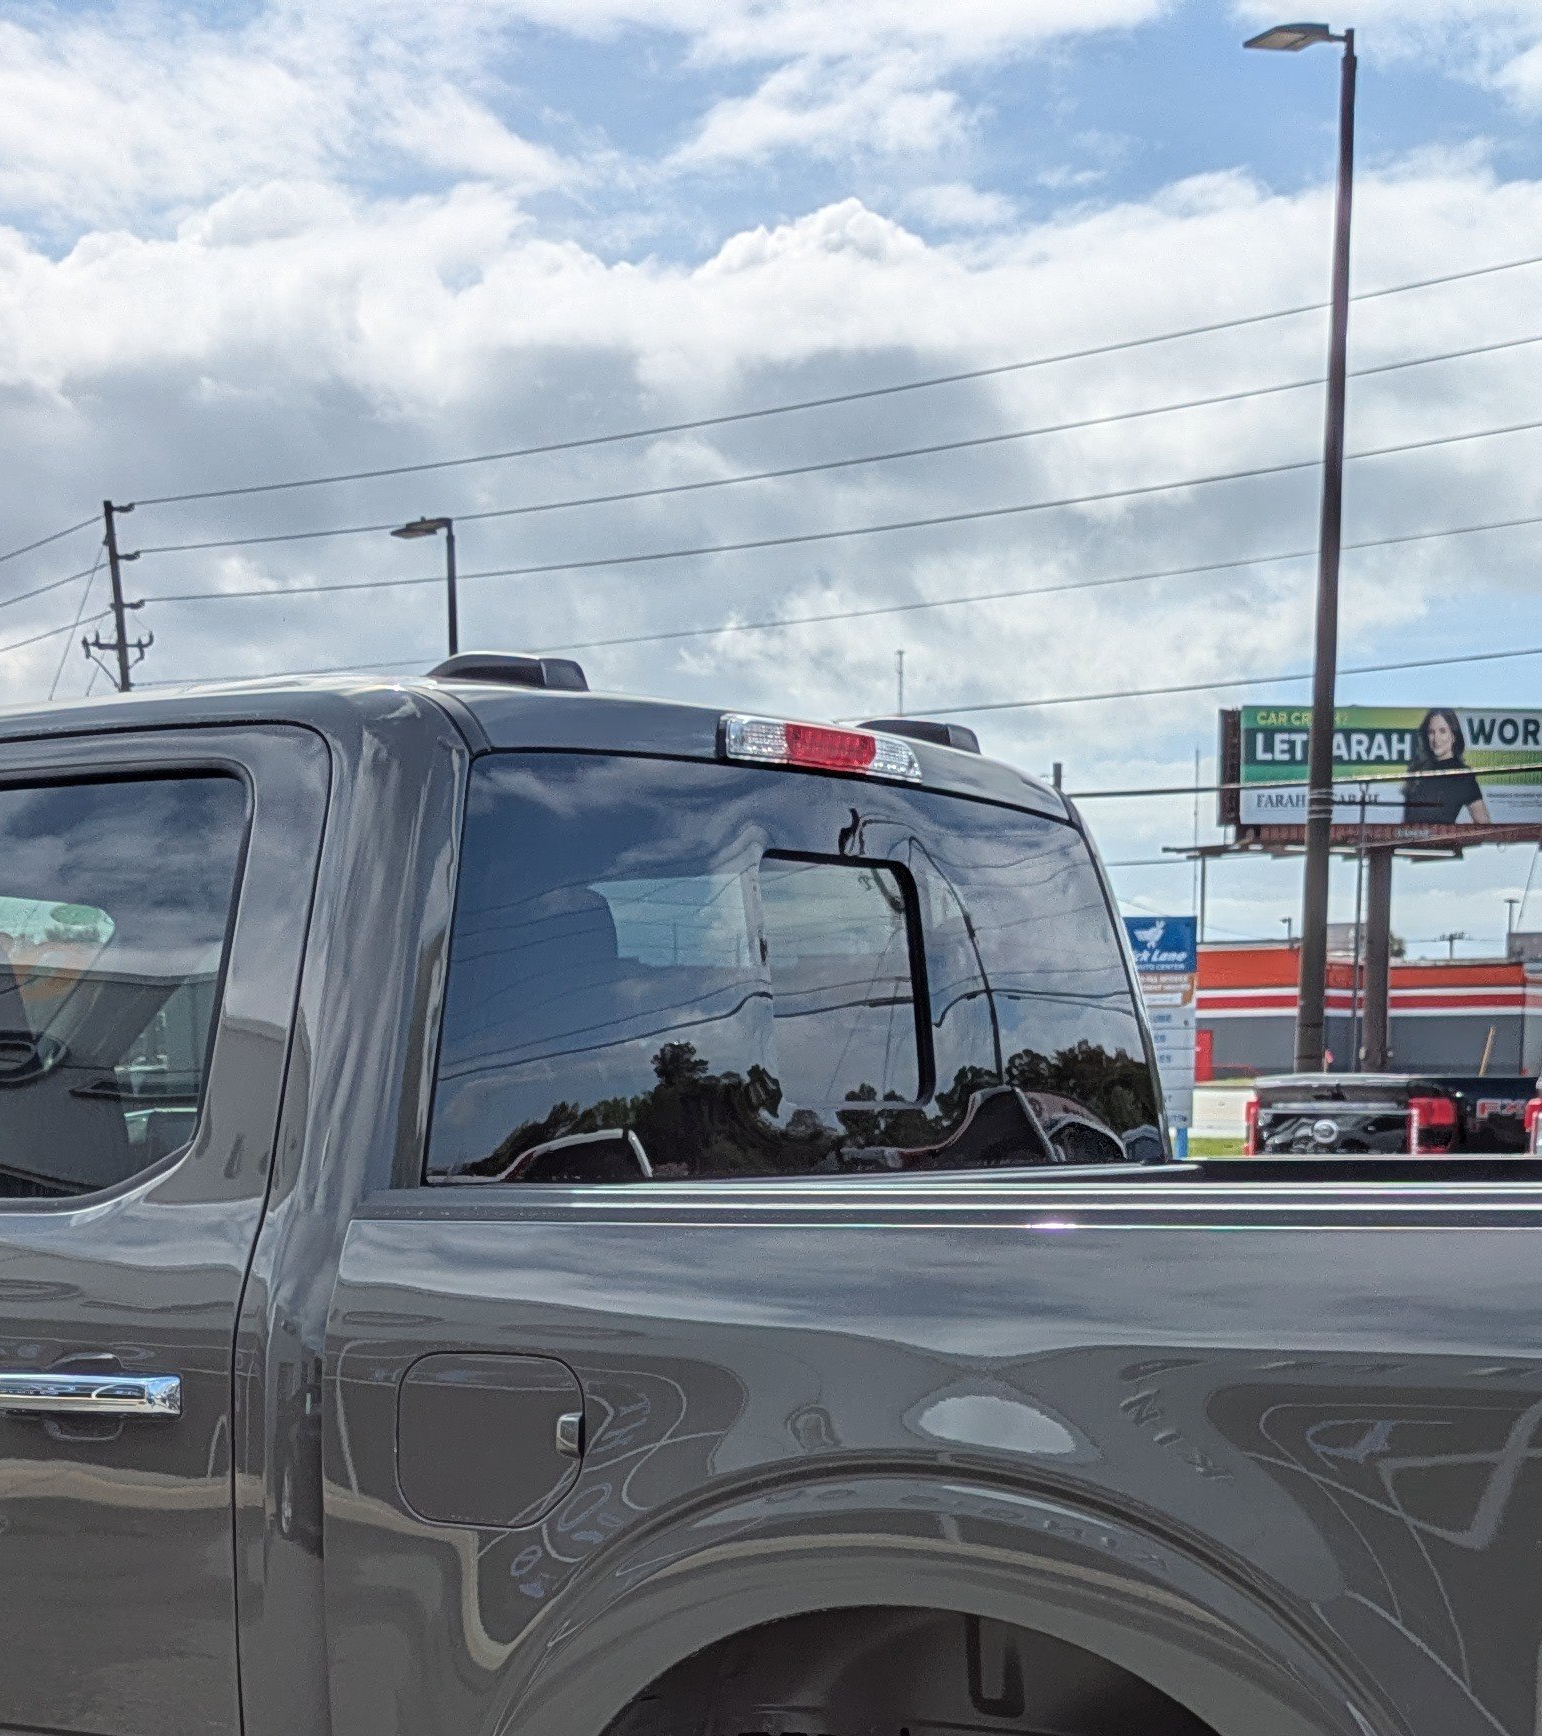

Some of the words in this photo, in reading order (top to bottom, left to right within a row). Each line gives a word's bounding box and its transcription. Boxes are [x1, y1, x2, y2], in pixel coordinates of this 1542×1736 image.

[1256, 711, 1289, 726] CAR
[1255, 732, 1309, 761] LET
[1331, 731, 1412, 761] ARAH
[1256, 793, 1306, 808] FARAH
